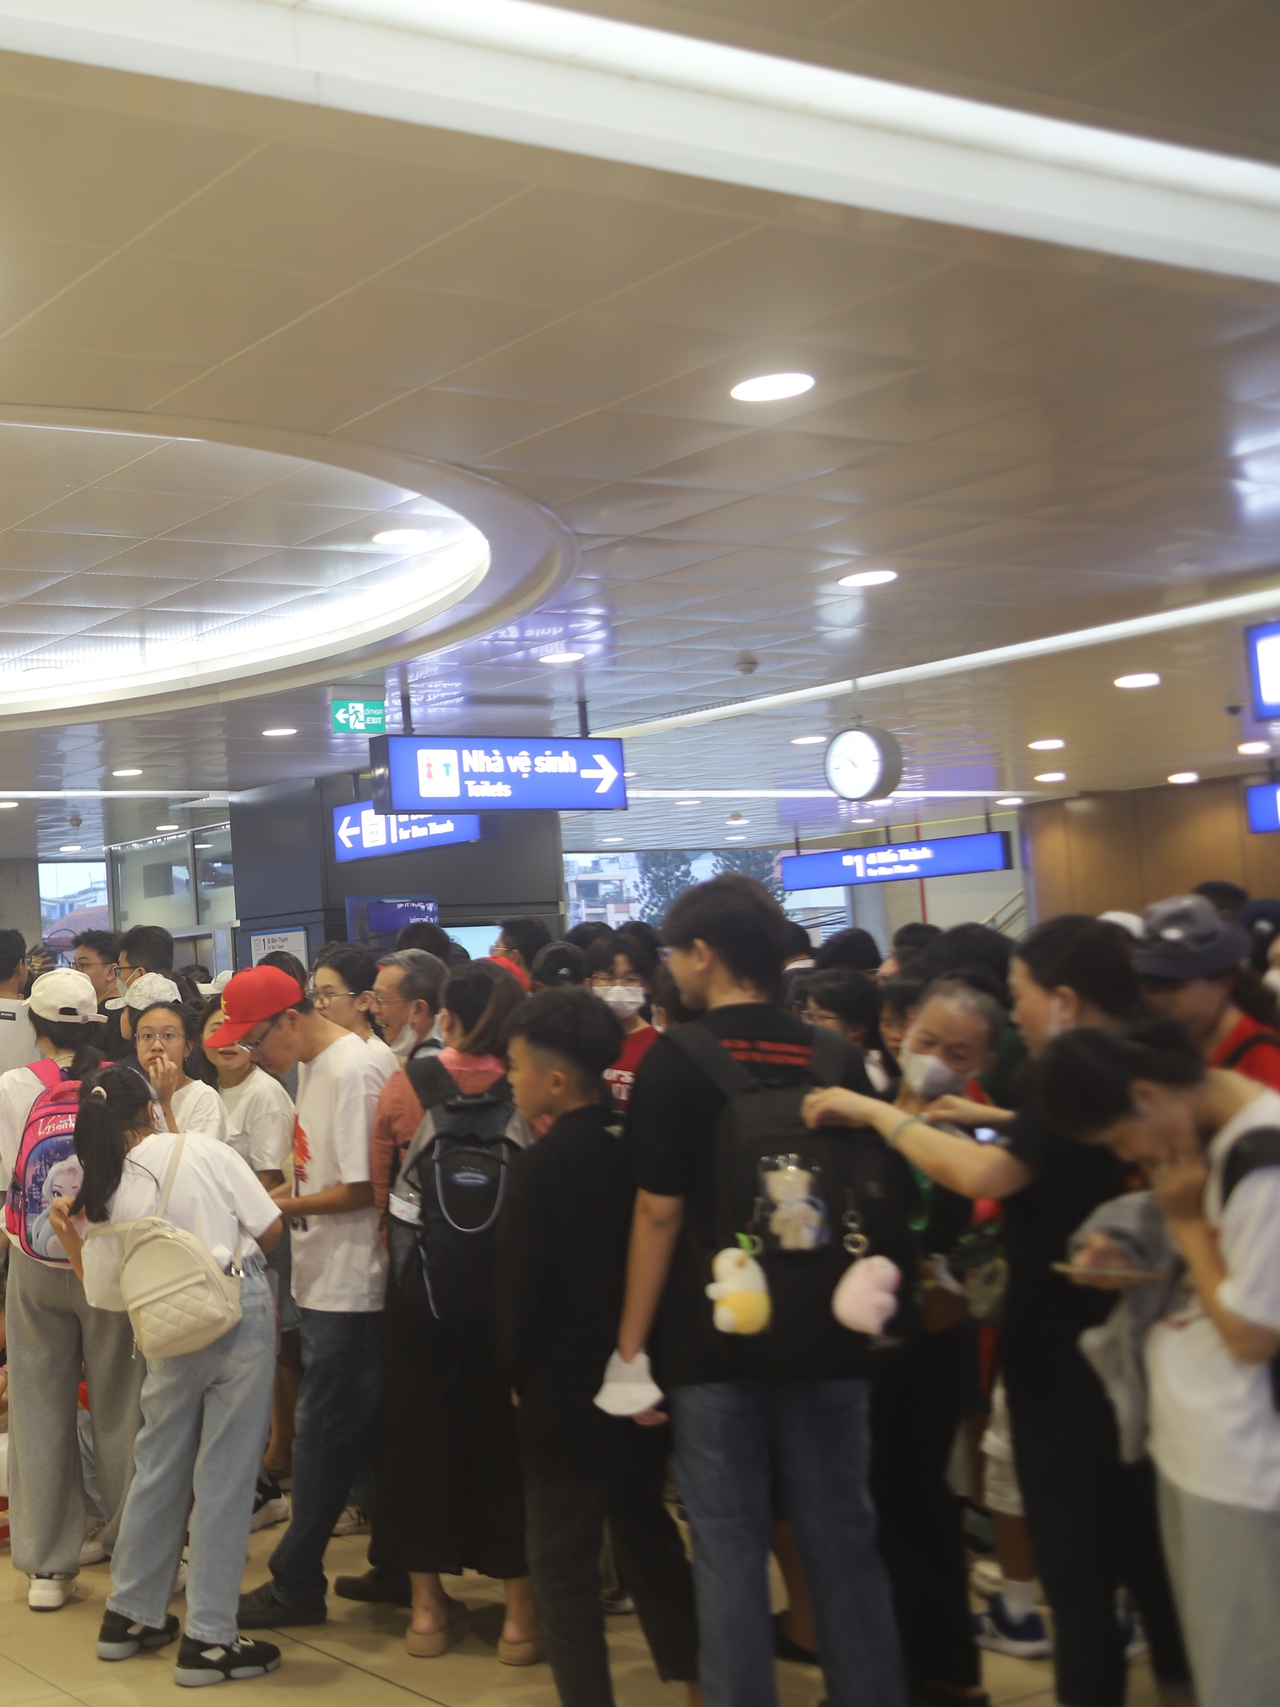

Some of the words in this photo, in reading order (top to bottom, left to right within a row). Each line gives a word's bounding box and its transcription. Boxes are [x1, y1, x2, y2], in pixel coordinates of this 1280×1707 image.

[366, 716, 383, 724] EXIT
[461, 749, 505, 773] Nhà
[505, 750, 532, 778] vệ
[533, 750, 578, 773] sinh
[463, 780, 513, 798] Toilets
